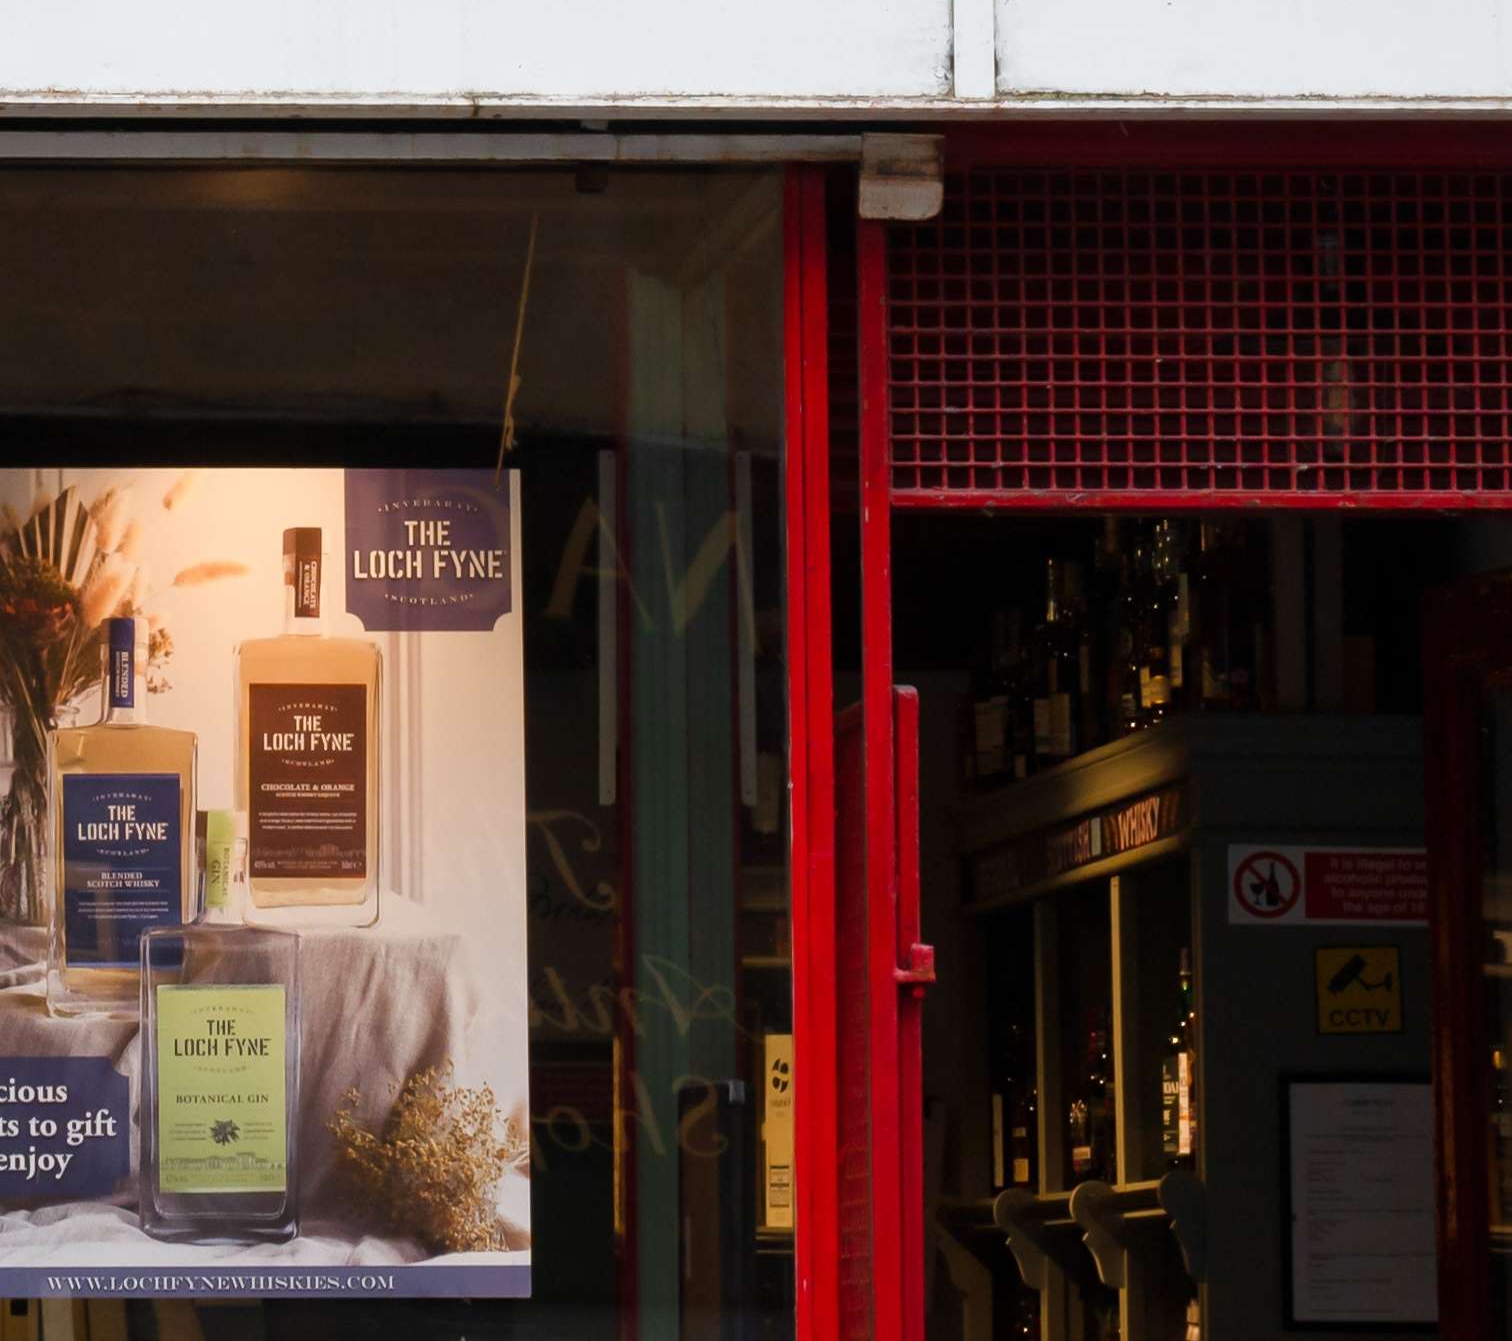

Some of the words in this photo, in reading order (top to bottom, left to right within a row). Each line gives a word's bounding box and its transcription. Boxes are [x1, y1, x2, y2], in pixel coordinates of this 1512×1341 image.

[383, 499, 474, 513] INVERARAY
[404, 521, 451, 546] THE
[354, 550, 423, 578] LOCH
[433, 550, 504, 578] FYNE
[390, 593, 470, 606] SCOTLAND
[120, 651, 129, 698] BLENDED
[293, 715, 322, 732] THE
[263, 733, 305, 751] LOCH
[310, 733, 353, 751] FYNE
[261, 783, 311, 792] CHOCOLATE
[320, 783, 355, 792] ORANGE
[107, 805, 136, 821] THE
[77, 822, 119, 841] LOCH
[125, 822, 167, 840] FYNE
[1118, 796, 1161, 850] WHISKY
[87, 880, 124, 888] SCOTCH
[125, 880, 160, 888] WHISKY
[1328, 1009, 1391, 1028] CCTV
[207, 1020, 236, 1036] THE
[174, 1038, 217, 1056] LOCH
[225, 1038, 270, 1056] FYNE
[176, 1094, 243, 1104] BOTANICAL
[247, 1094, 269, 1103] GIN
[29, 1117, 58, 1137] to
[66, 1109, 117, 1145] gift
[47, 1275, 395, 1291] WWW.LOCHFYNEWHISKIES.COM
